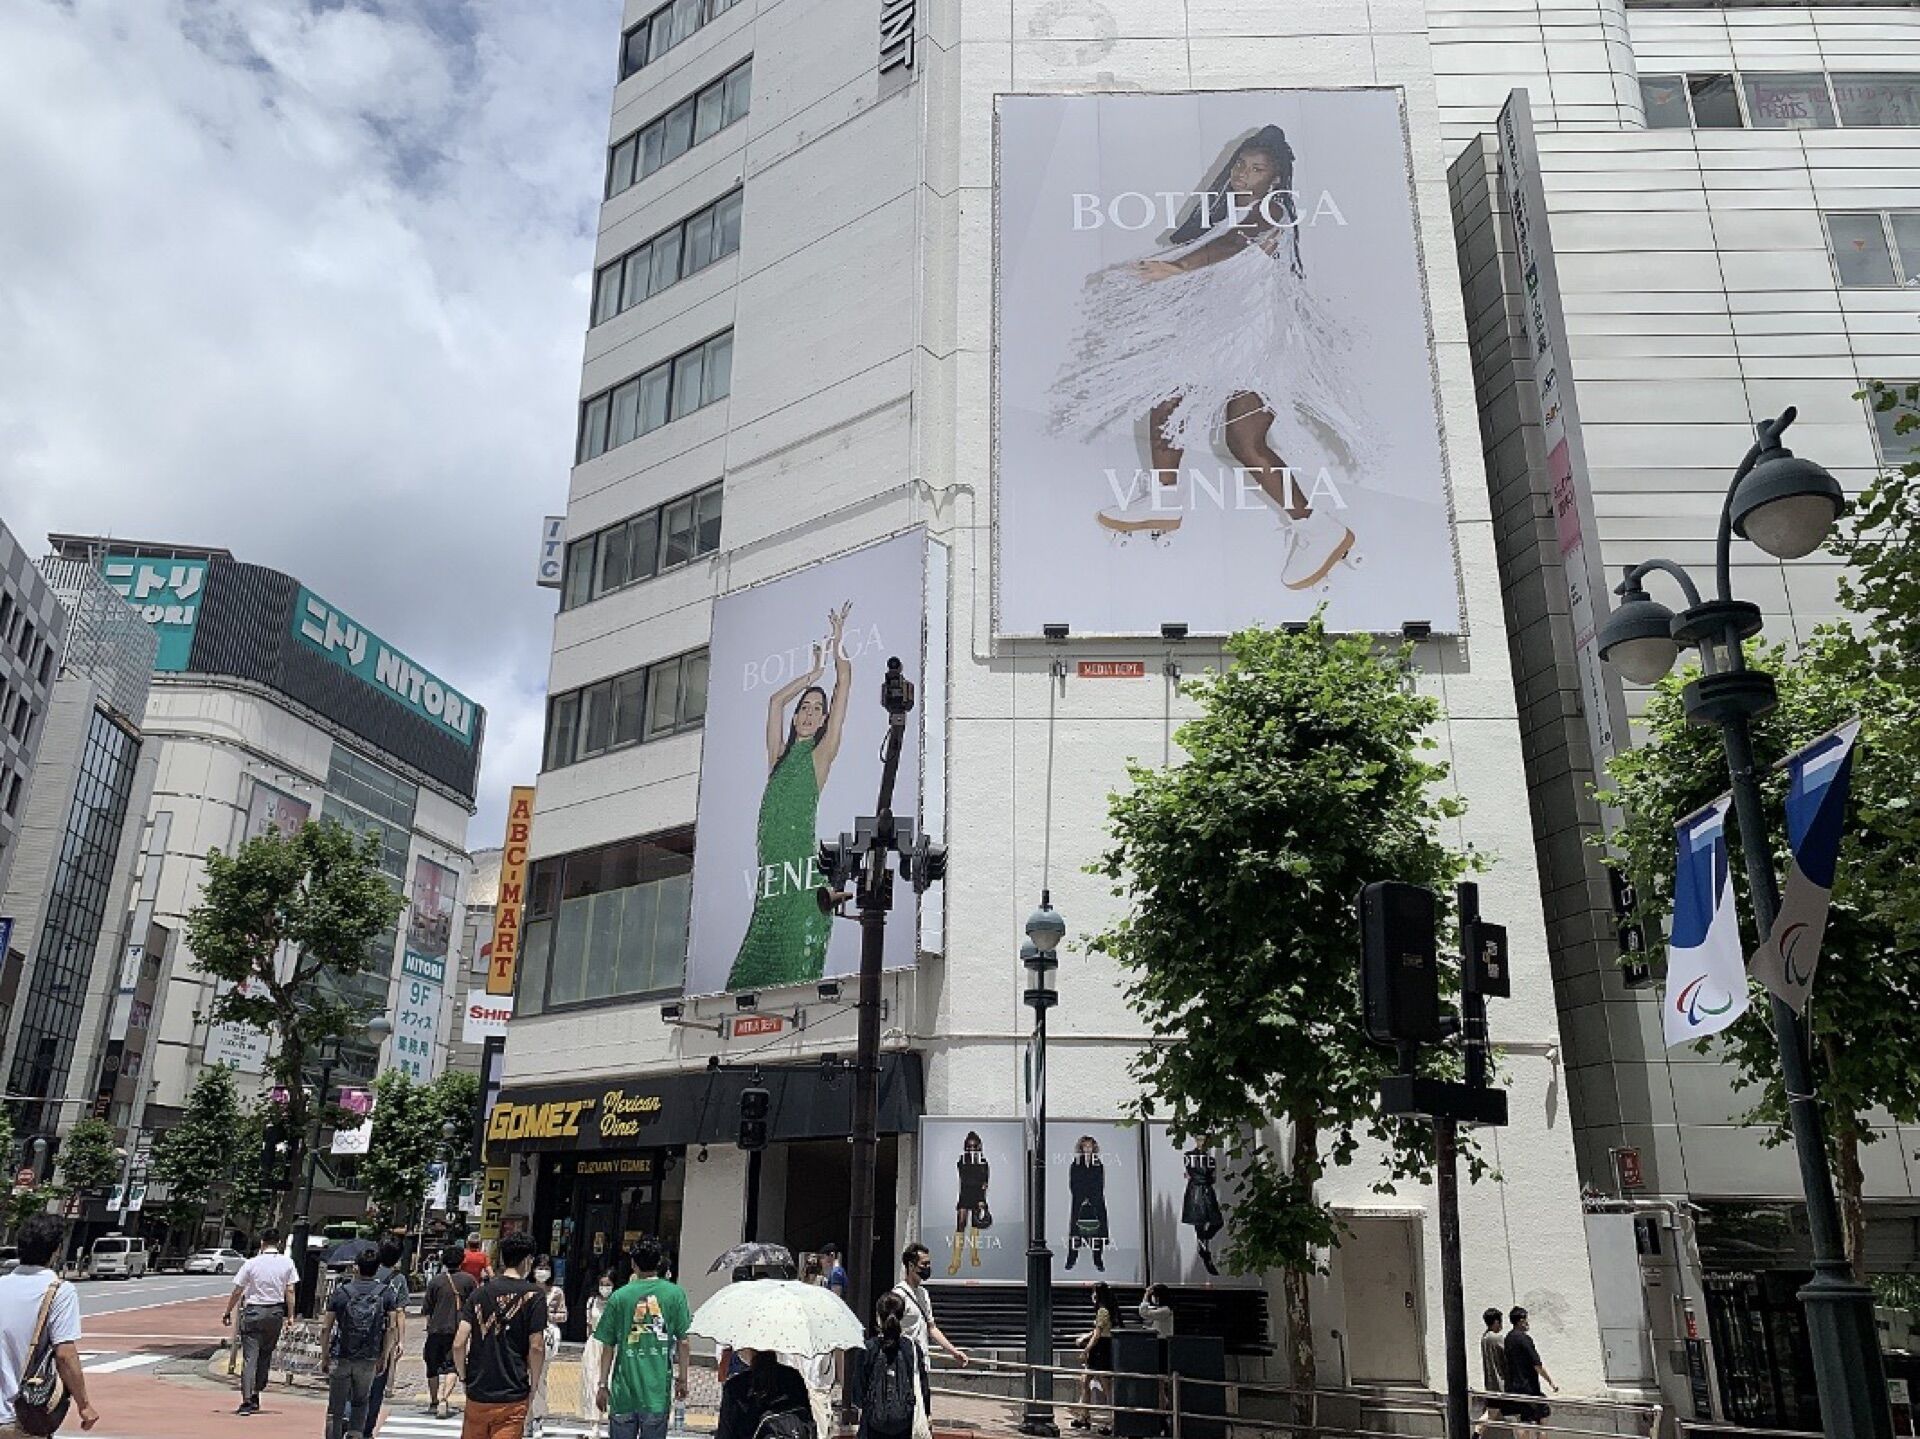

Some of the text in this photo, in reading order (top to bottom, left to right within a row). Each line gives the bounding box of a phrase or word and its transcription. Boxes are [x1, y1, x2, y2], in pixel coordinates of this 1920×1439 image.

[880, 0, 913, 75] INT
[1071, 189, 1349, 231] BOTTEGA
[1103, 467, 1348, 512] VENETA
[541, 521, 561, 577] ITC
[106, 564, 204, 600] ニトリ
[301, 597, 472, 736] ニトリ NITORI
[494, 800, 531, 978] ABC-MART
[743, 856, 823, 900] VENE
[406, 954, 442, 979] NITORI
[410, 982, 431, 1006] 9F
[488, 1101, 583, 1141] GOMEZ
[603, 1090, 661, 1113] Mexican
[944, 1234, 1003, 1250] VENETA
[1061, 1236, 1119, 1251] VENETA
